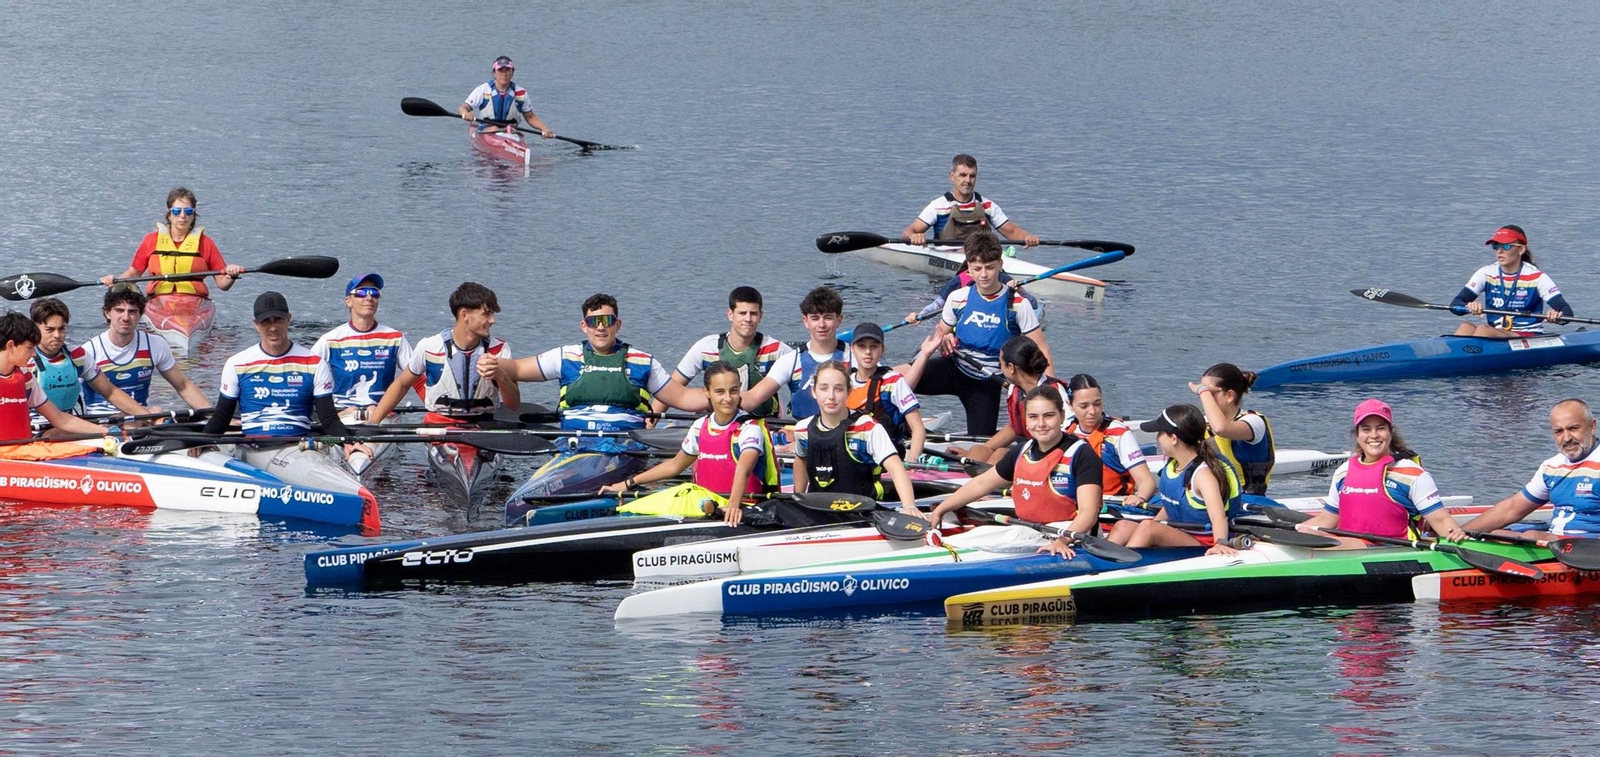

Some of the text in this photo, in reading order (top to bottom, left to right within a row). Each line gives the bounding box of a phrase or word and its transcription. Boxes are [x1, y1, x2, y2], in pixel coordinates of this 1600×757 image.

[1290, 363, 1308, 372] CLUB
[1362, 351, 1390, 362] OLIVICO
[10, 476, 78, 490] PIRAGÜISMO
[96, 482, 142, 494] OLIVICO
[200, 486, 256, 499] ELIO
[294, 492, 334, 504] OLIVICO
[564, 510, 588, 520] CLUB
[318, 556, 347, 568] CLUB
[637, 556, 667, 567] CLUB
[728, 578, 910, 596] CLUB PIRAGÜISMO OLIVICO
[1452, 576, 1486, 586] CLUB
[990, 598, 1076, 616] CLUB PIRAGÜIS
